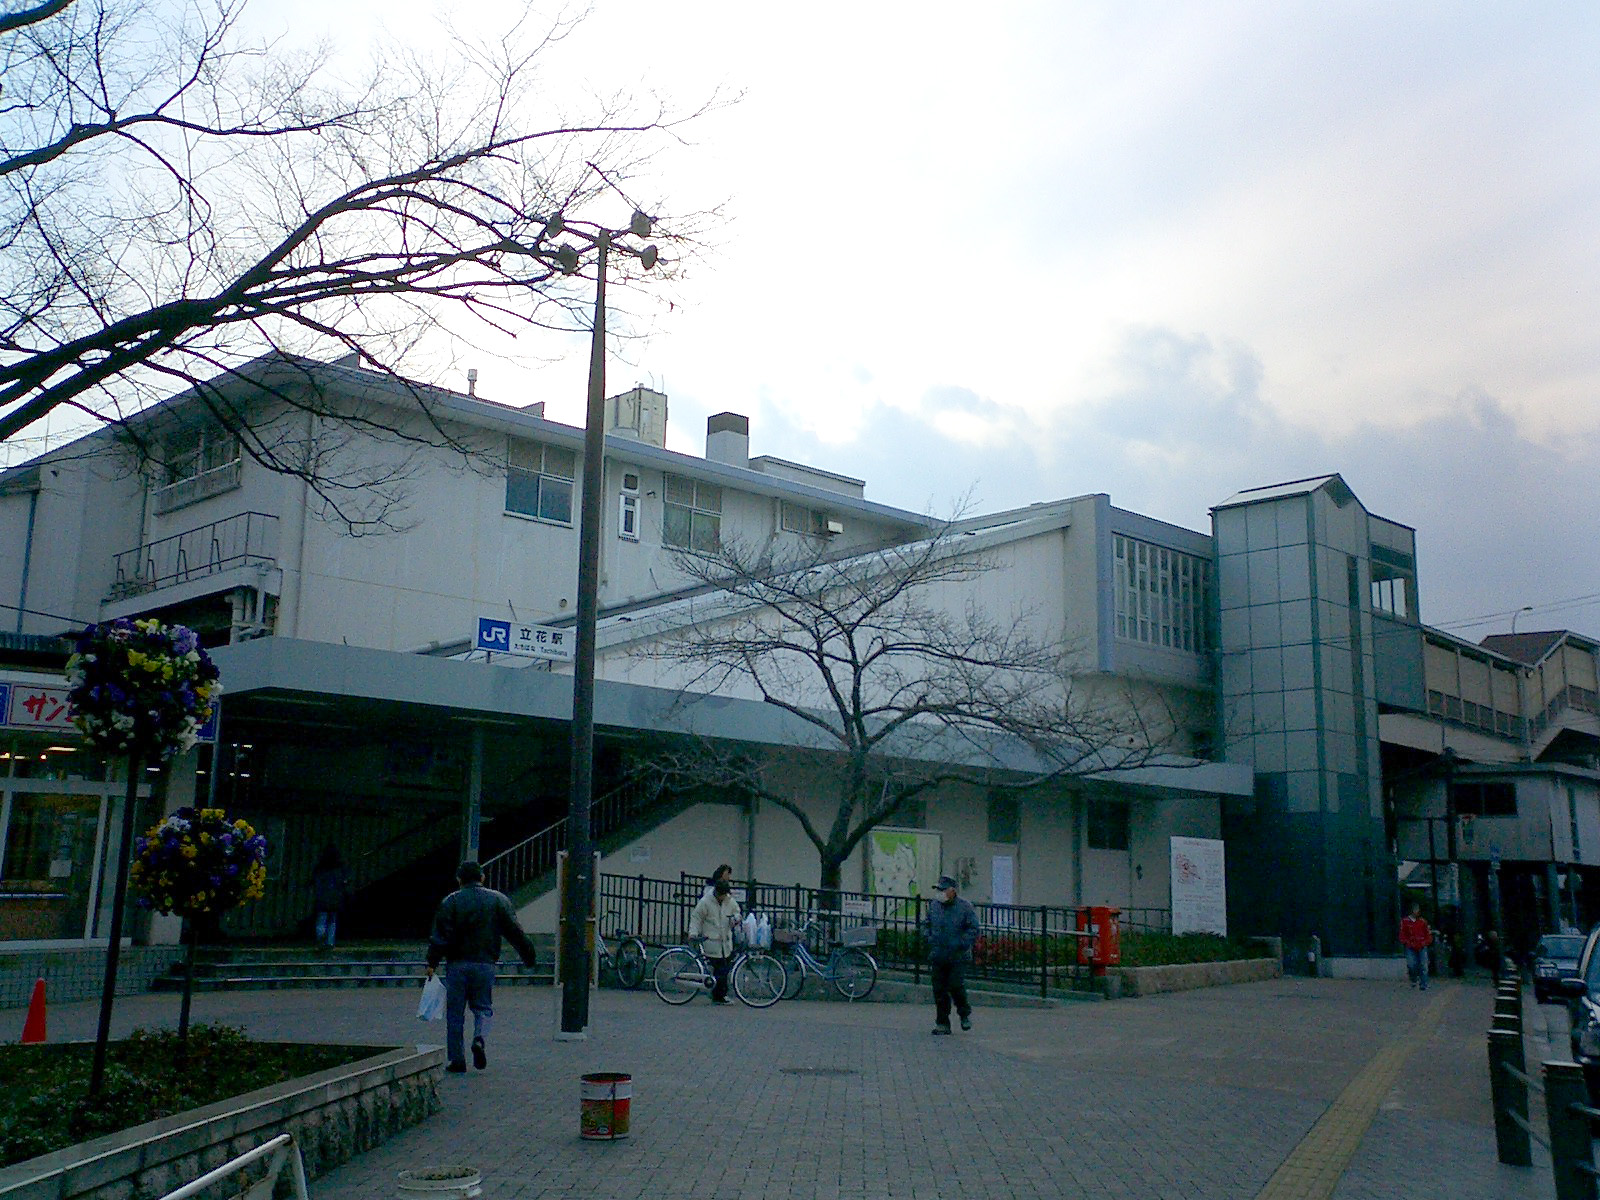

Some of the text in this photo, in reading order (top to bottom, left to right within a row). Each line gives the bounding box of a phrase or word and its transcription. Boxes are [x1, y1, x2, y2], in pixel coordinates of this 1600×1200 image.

[483, 627, 507, 643] JR
[520, 628, 563, 645] 立花駅
[22, 692, 75, 723] サン
